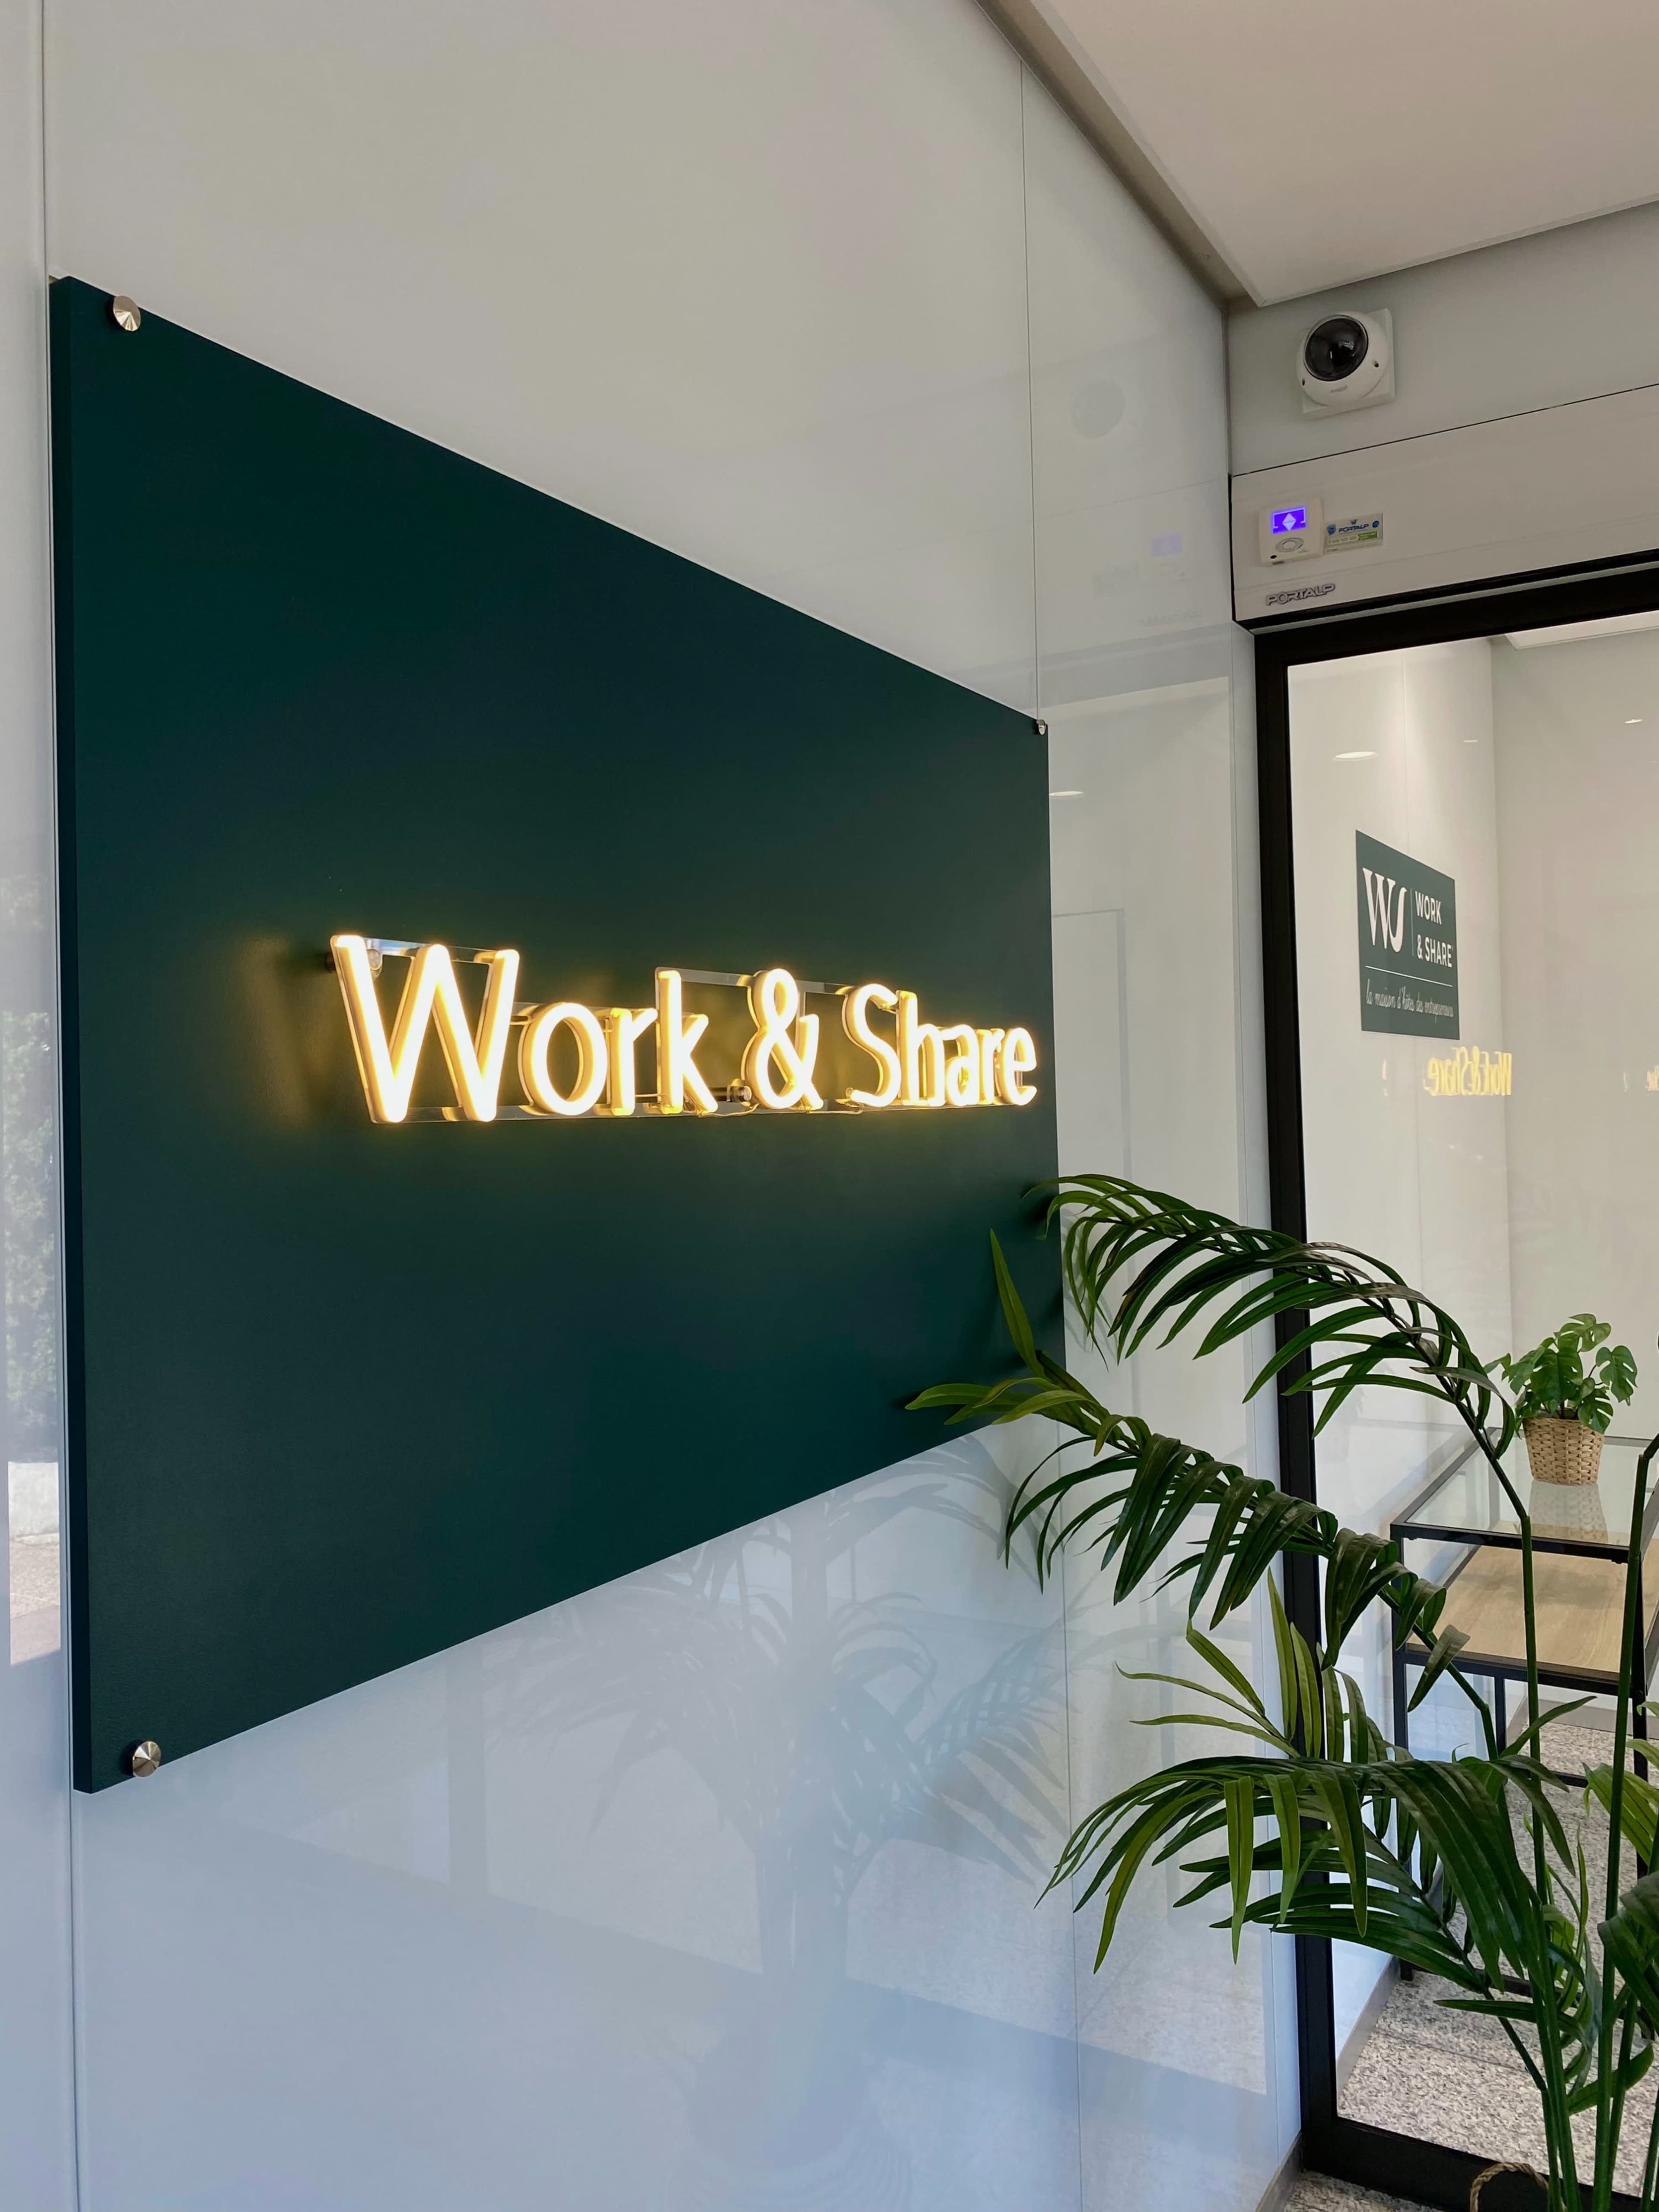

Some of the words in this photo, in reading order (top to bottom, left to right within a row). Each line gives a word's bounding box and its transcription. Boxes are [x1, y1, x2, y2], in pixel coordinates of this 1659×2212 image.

[1265, 583, 1336, 606] PORTALP
[1415, 890, 1442, 925] WORK
[1417, 934, 1423, 960] &
[1425, 936, 1452, 968] SHARE
[330, 933, 719, 1123] Work
[743, 967, 824, 1112] &
[842, 982, 1038, 1107] Share
